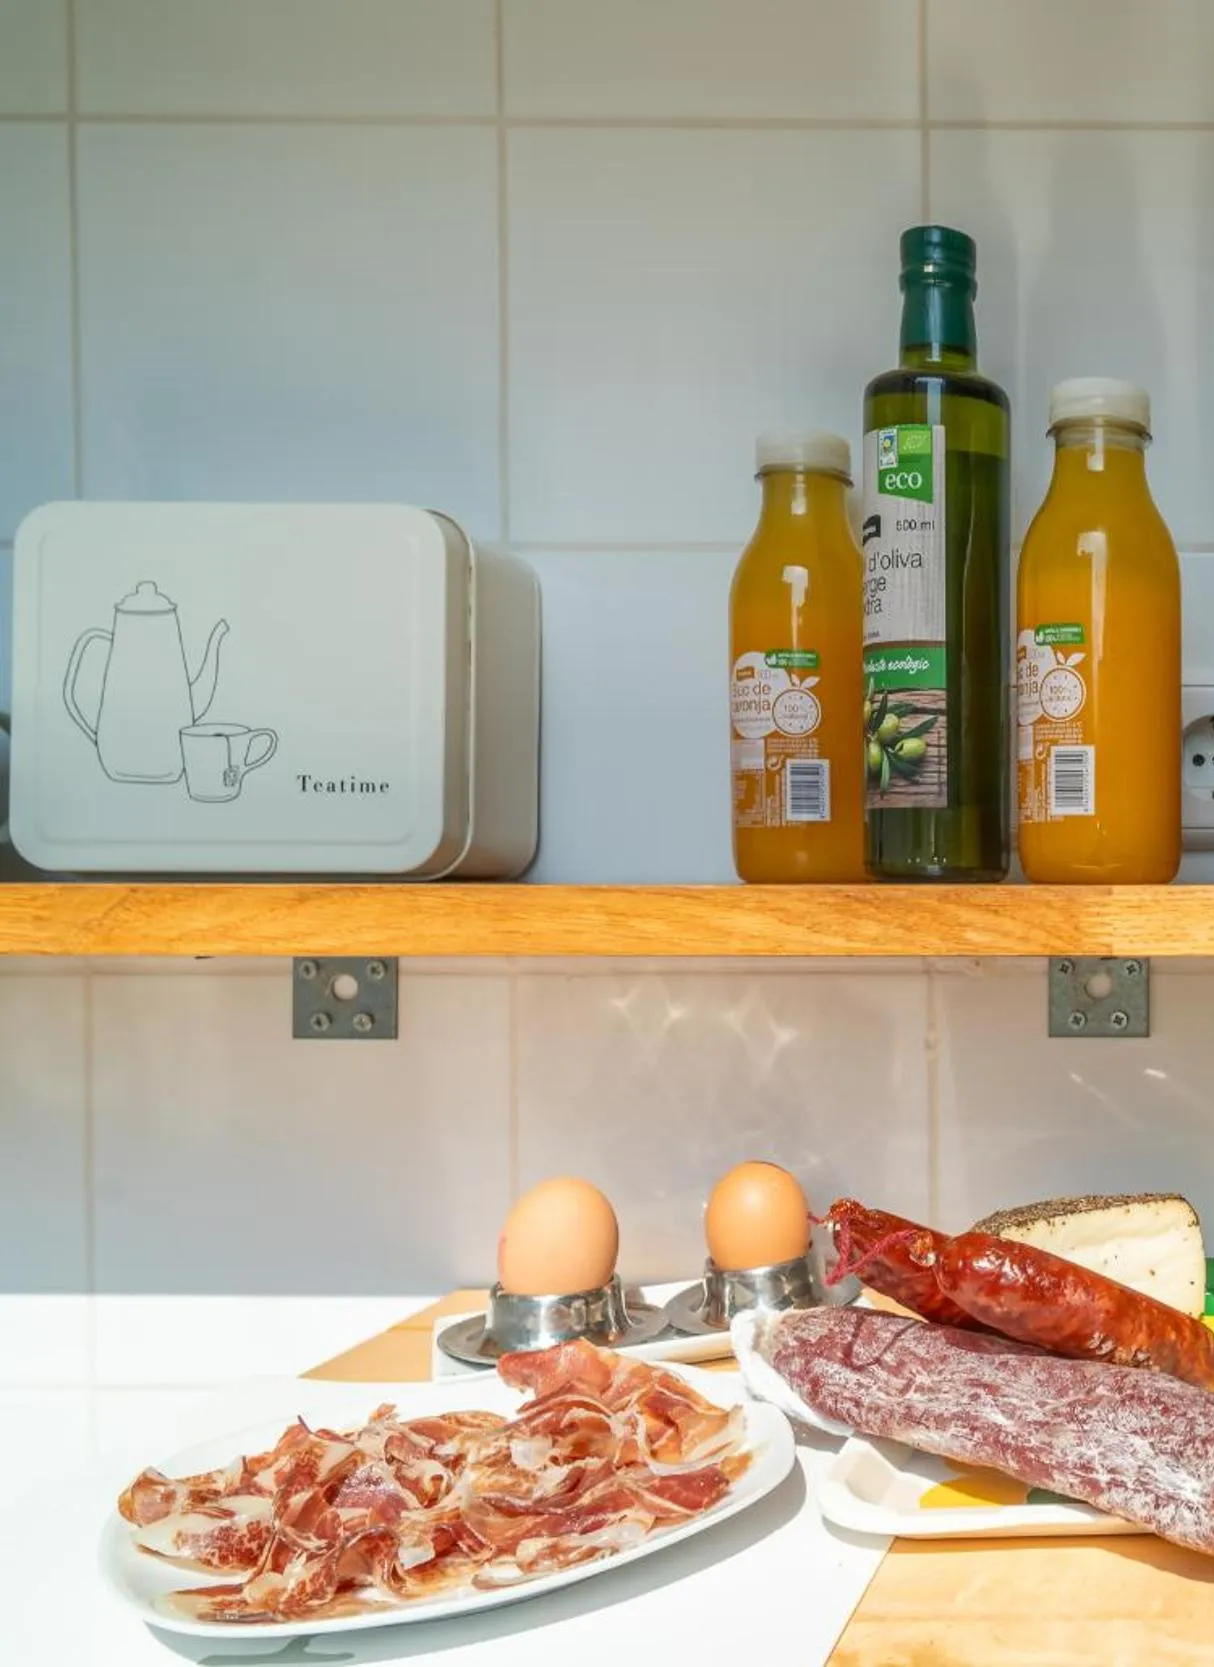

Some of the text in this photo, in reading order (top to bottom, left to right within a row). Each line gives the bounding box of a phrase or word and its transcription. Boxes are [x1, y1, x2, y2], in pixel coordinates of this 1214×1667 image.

[885, 471, 923, 490] eco
[896, 519, 935, 532] 500 ml
[868, 547, 923, 573] d'oliva
[863, 575, 887, 598] rge
[863, 597, 883, 617] tra
[752, 680, 772, 696] de
[297, 774, 390, 794] Teatime
